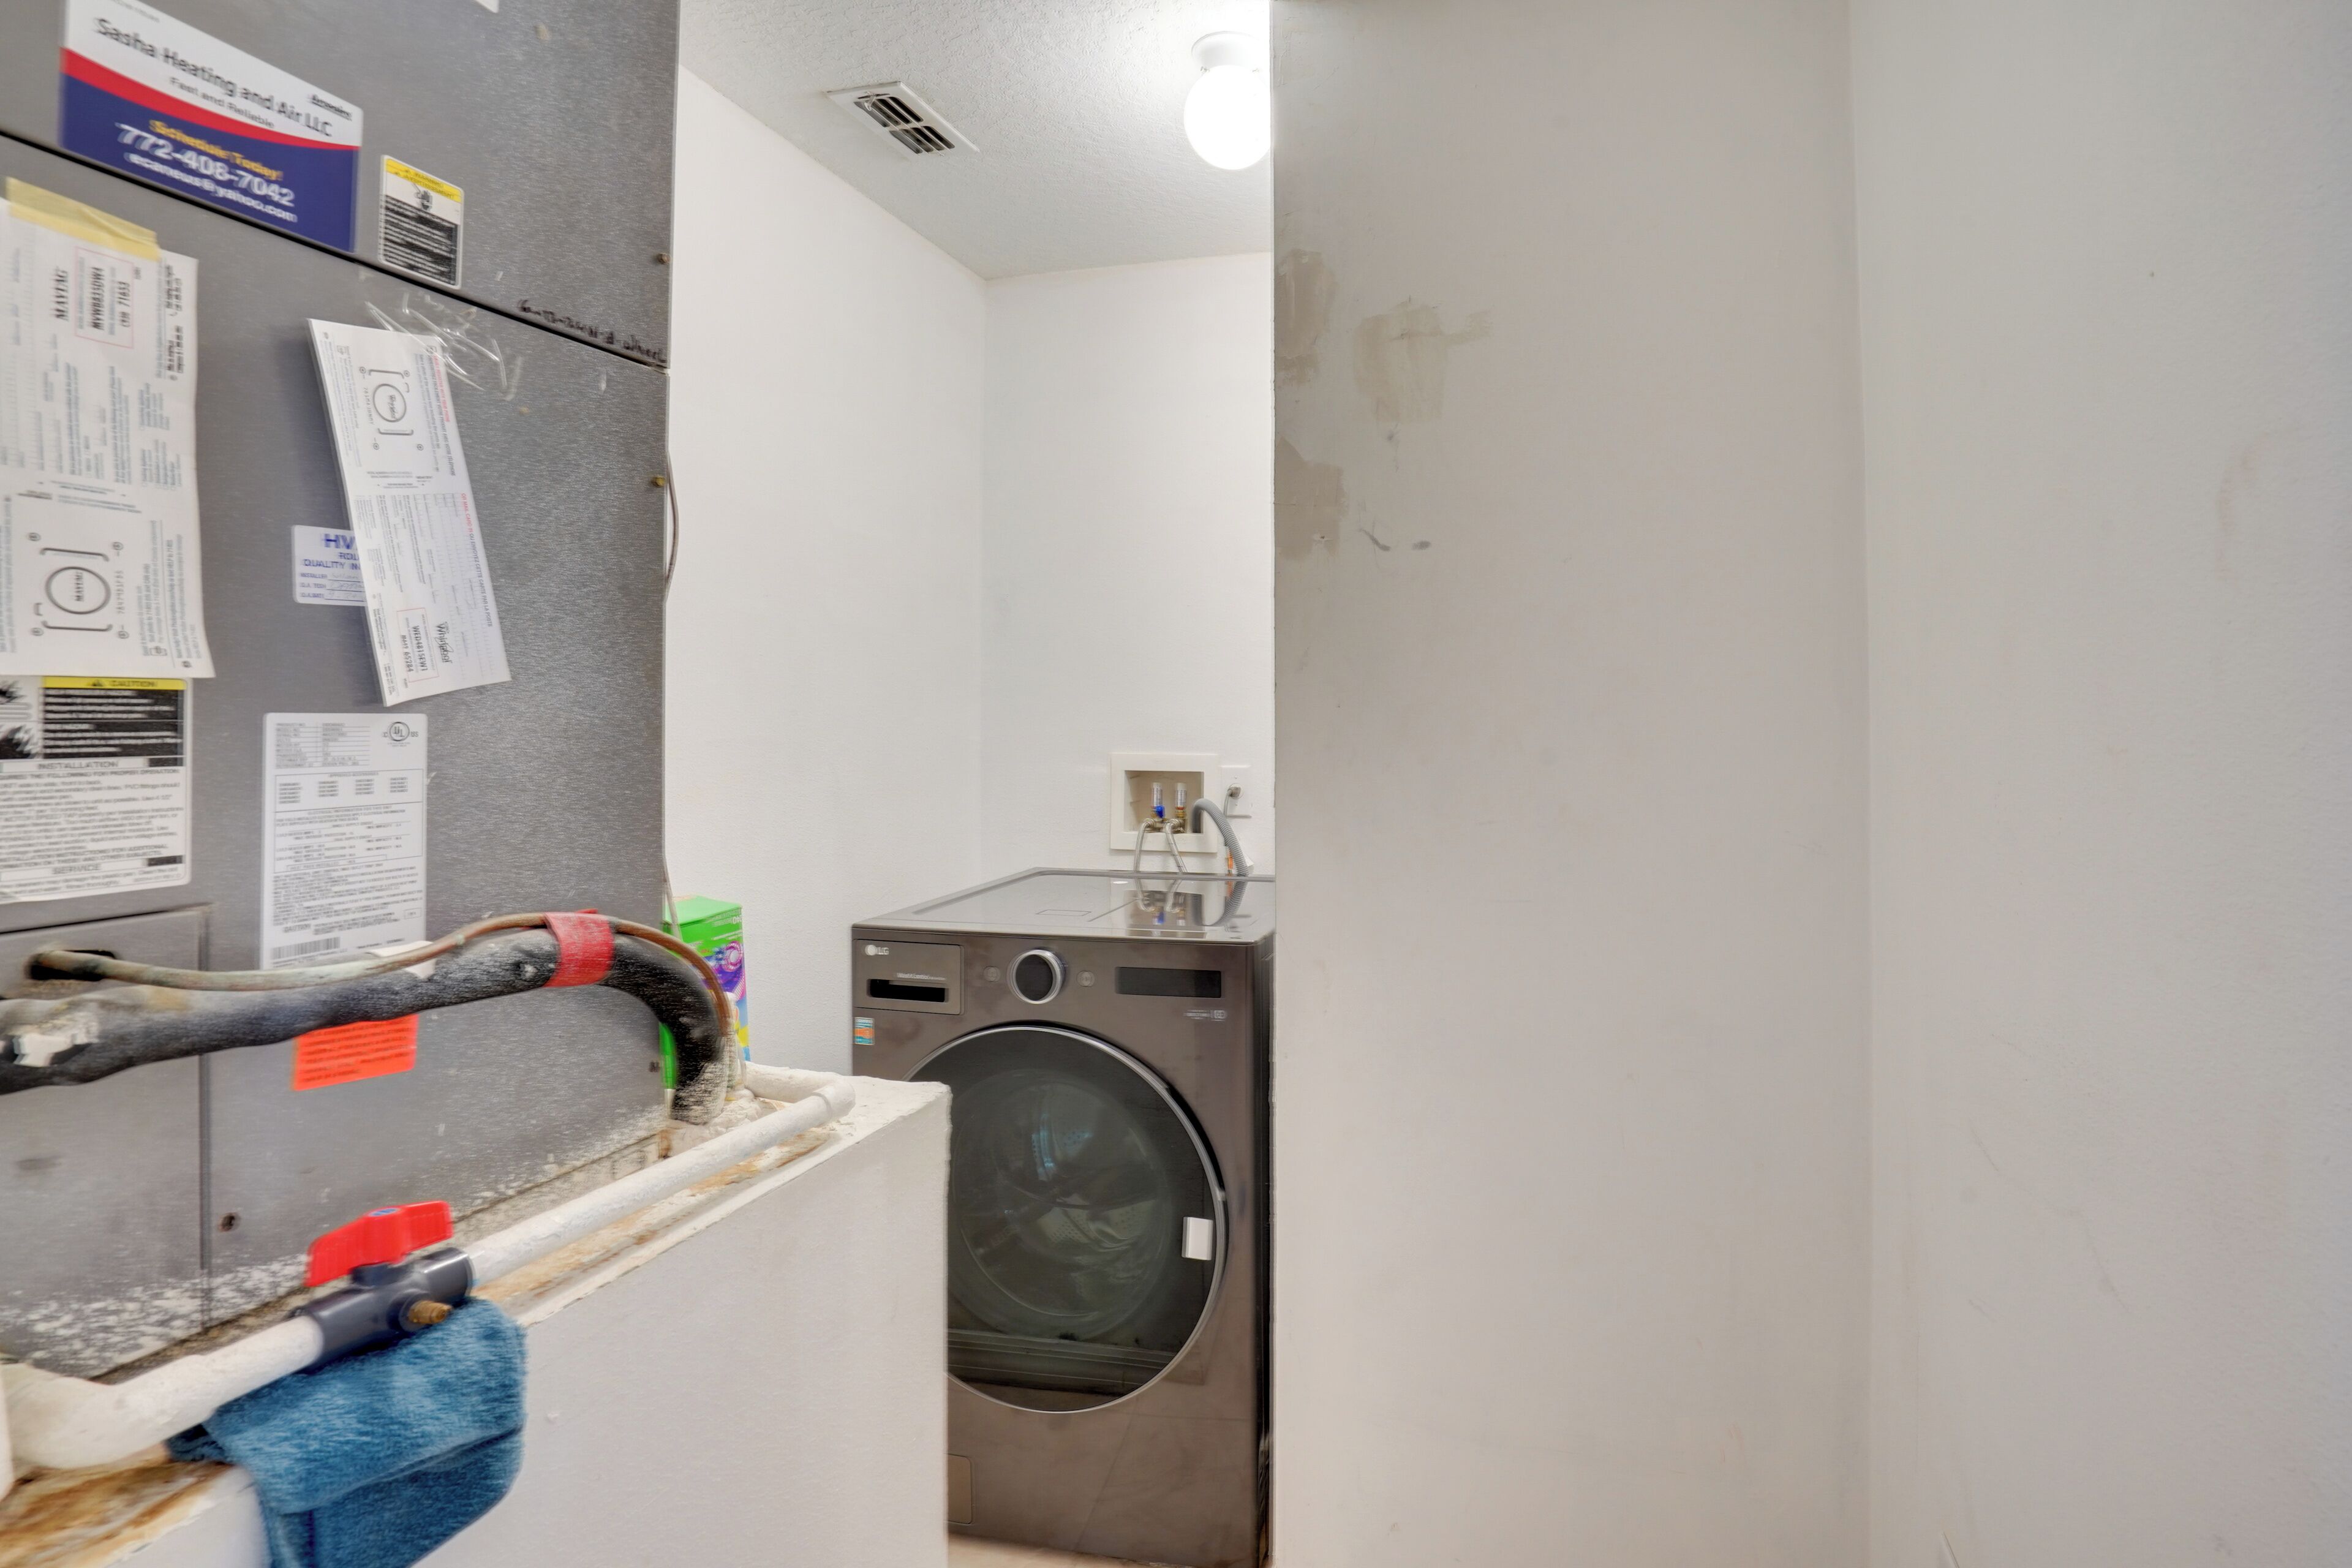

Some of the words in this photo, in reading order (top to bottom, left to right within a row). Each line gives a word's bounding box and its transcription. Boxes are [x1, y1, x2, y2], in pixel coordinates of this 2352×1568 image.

[94, 17, 157, 59] Sasha
[162, 47, 237, 97] Heating
[240, 88, 274, 111] and
[277, 101, 303, 123] Air
[304, 112, 333, 137] LLC
[170, 77, 198, 99] Fast
[203, 92, 225, 108] and
[227, 102, 274, 129] Reliable
[115, 122, 295, 208] 772-408-7042
[51, 268, 69, 322] MAYTAG
[325, 533, 355, 549] HV
[461, 492, 467, 501] OR
[470, 541, 480, 564] ENVOYEZ
[303, 559, 345, 569] QUALITY
[403, 650, 414, 673] 65284
[411, 625, 429, 672] WED4815EW1
[434, 622, 453, 664] Whirlpool
[37, 760, 119, 769] INSTALLATION
[876, 947, 889, 956] LG
